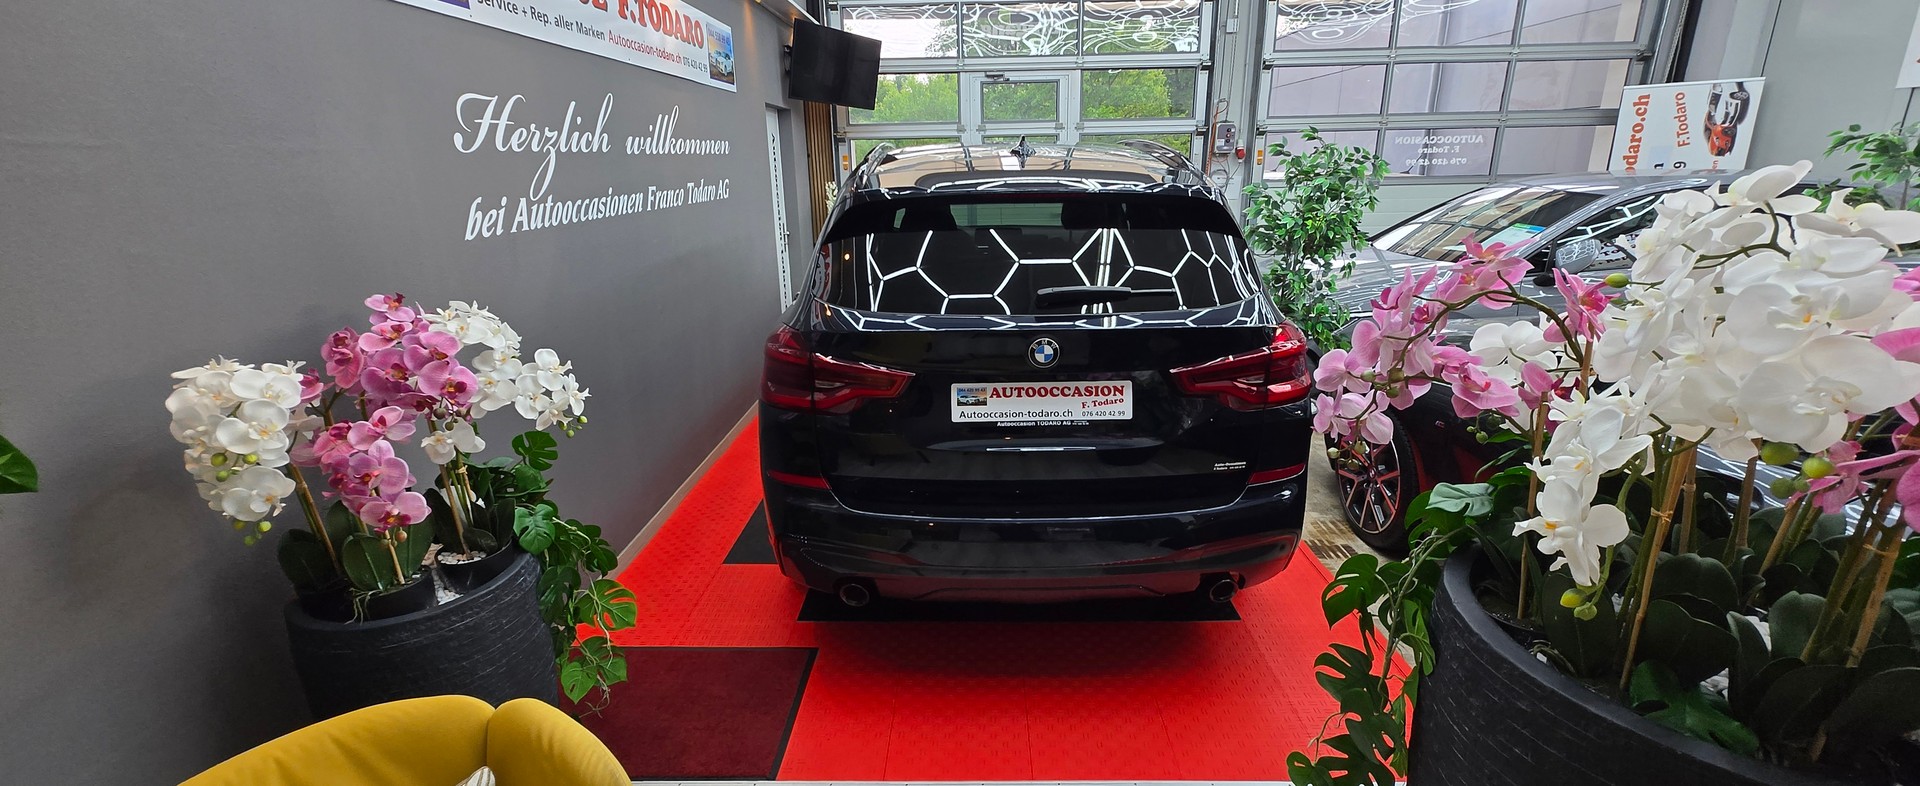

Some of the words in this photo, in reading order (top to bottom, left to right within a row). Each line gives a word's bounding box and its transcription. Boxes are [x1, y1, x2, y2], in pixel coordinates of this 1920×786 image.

[477, 0, 519, 15] ervice
[521, 8, 528, 17] +
[529, 6, 552, 26] Rep.
[554, 14, 574, 32] aller
[575, 20, 606, 41] Marken
[608, 29, 683, 64] Autooccasion-todaro.ch
[453, 92, 612, 201] Herzlich
[625, 105, 731, 156] willkommen
[464, 196, 507, 241] bei
[510, 187, 644, 234] Autooccasionen
[646, 185, 685, 211] Franco
[687, 178, 716, 205] Todaro
[716, 178, 730, 200] AG
[989, 385, 1125, 399] AUTOOCCASION
[1081, 401, 1090, 409] F.
[1091, 398, 1124, 408] Todaro
[959, 409, 1073, 419] Autooccasion-todaro.ch
